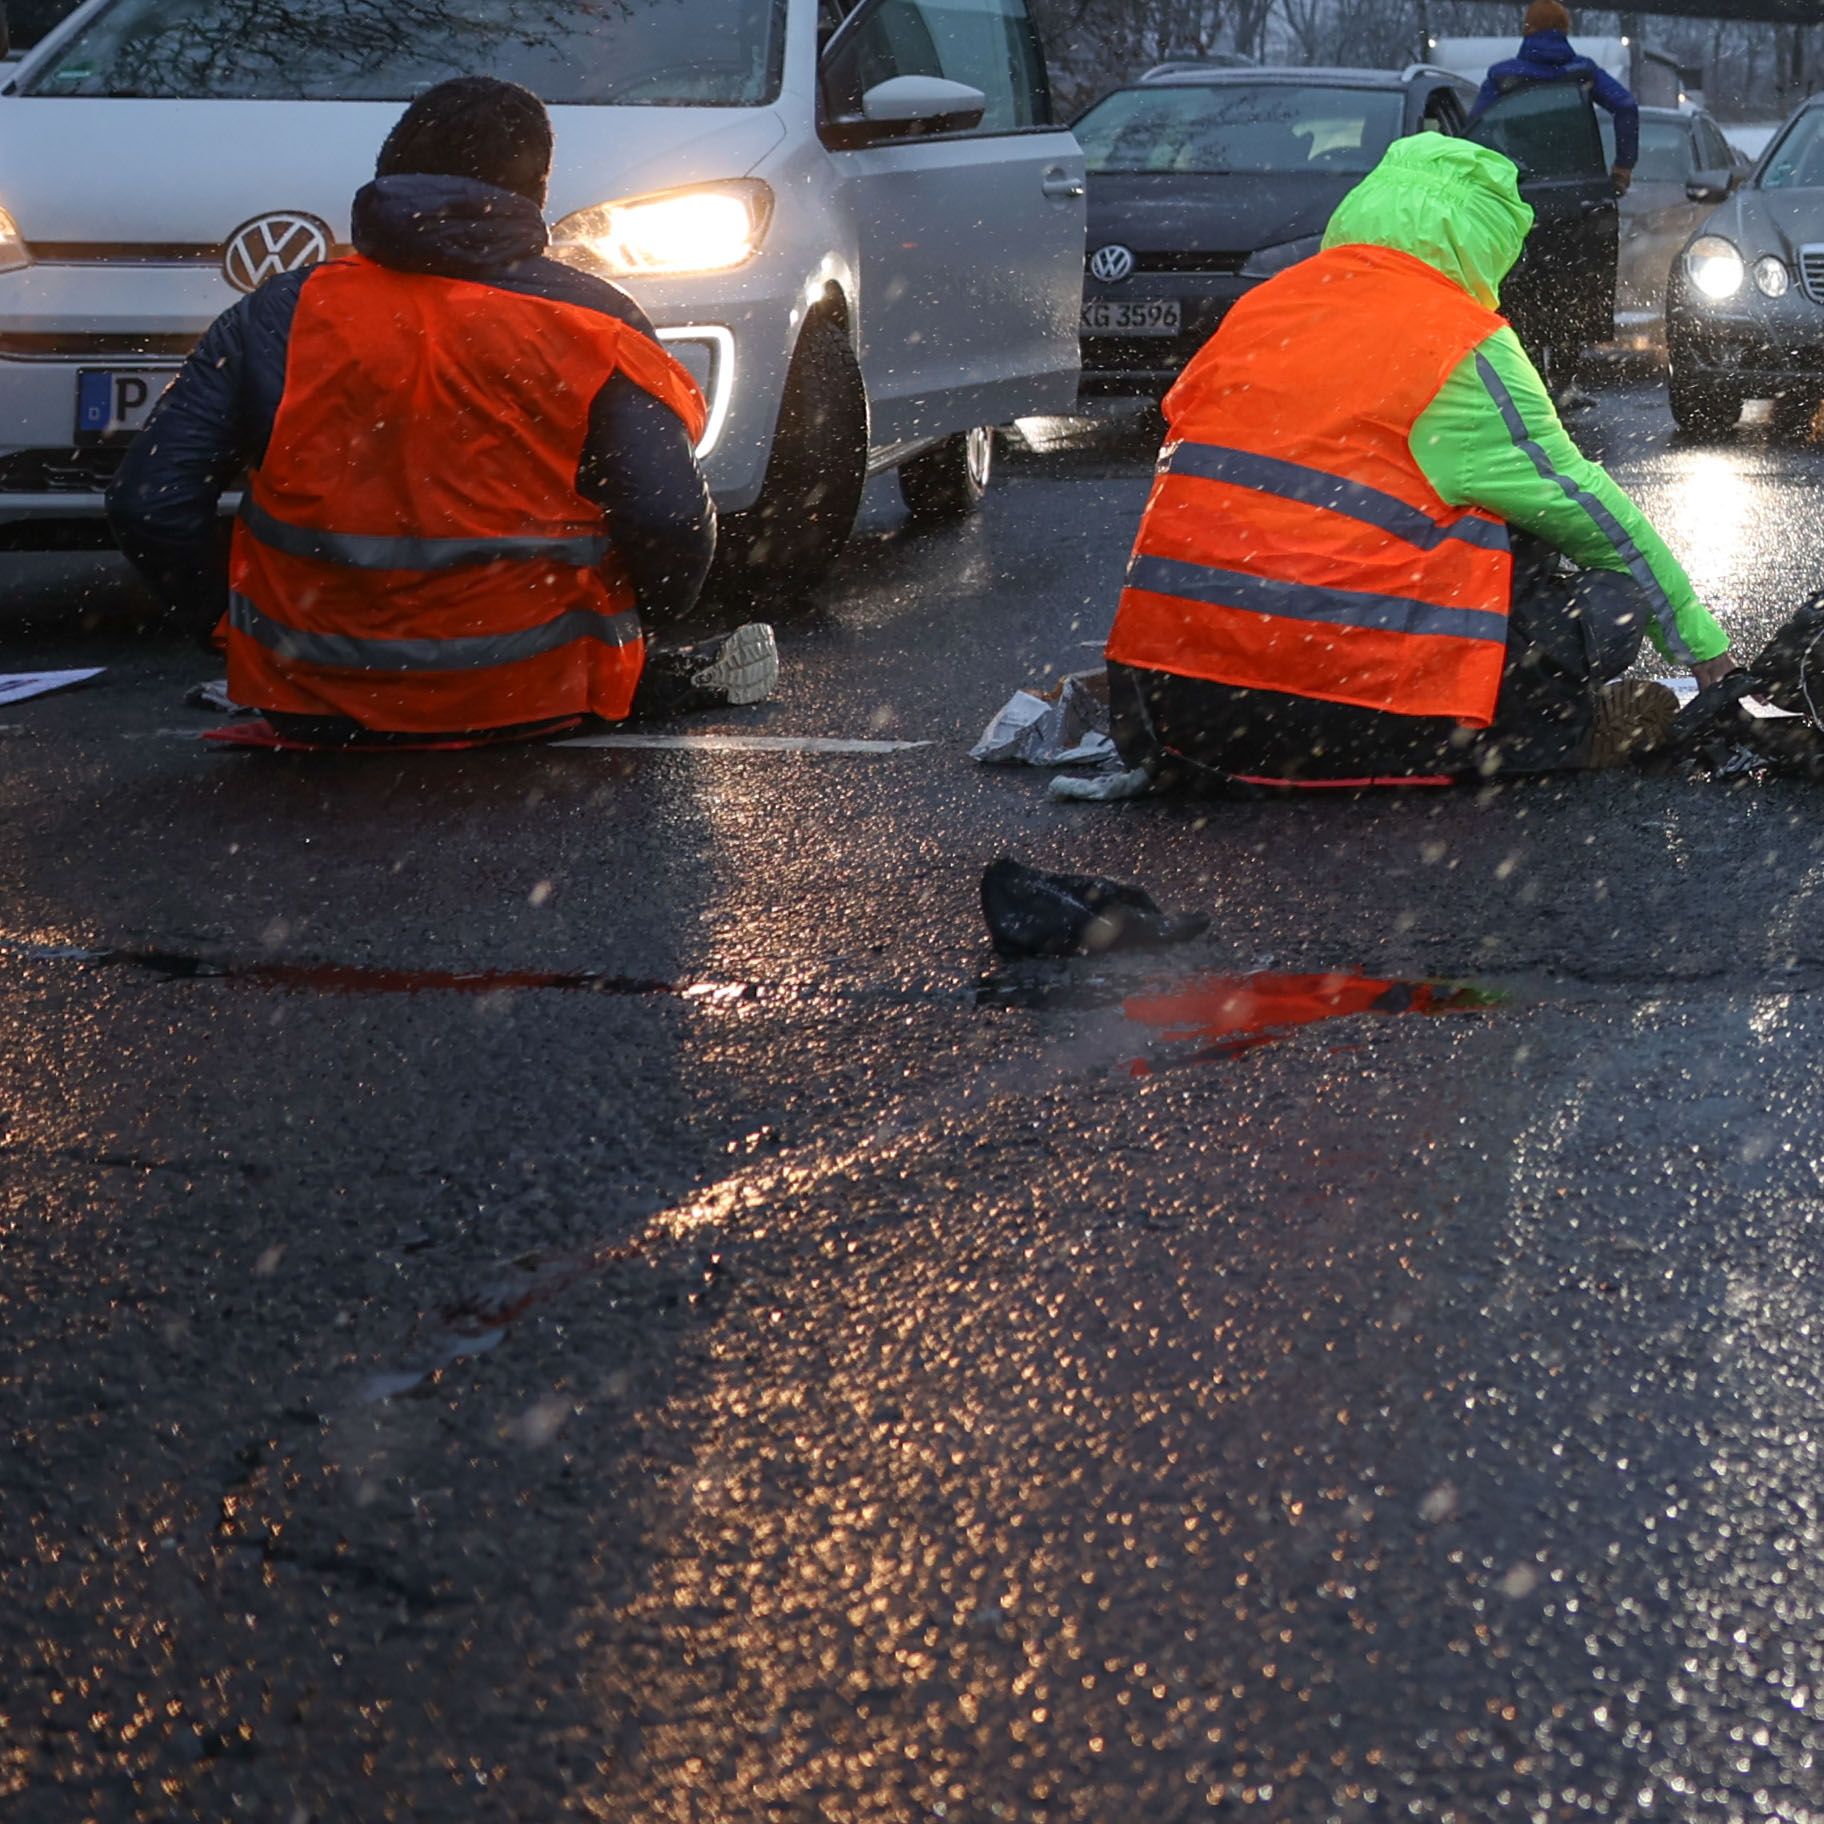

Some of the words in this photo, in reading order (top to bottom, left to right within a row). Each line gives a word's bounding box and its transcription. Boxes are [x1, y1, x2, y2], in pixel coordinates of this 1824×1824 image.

[1092, 245, 1131, 281] VW
[1116, 305, 1177, 328] 3596
[115, 378, 147, 421] P
